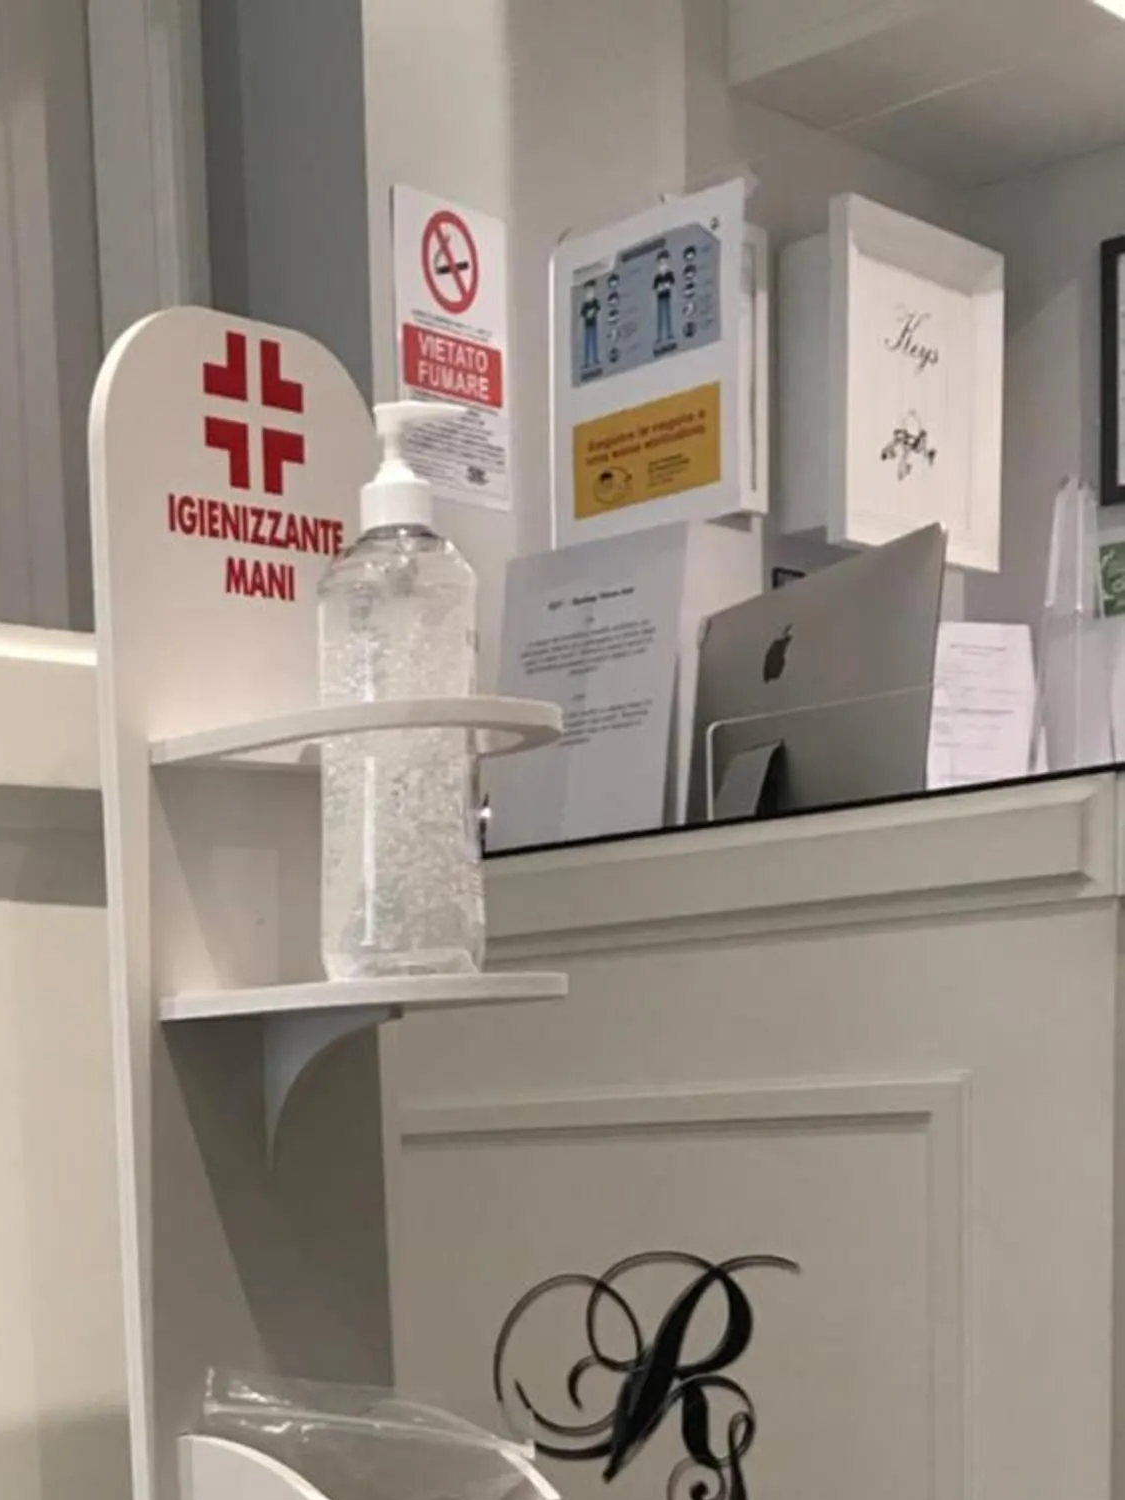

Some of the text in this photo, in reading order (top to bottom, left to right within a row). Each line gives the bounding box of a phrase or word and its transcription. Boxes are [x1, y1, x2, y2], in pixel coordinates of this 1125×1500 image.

[417, 331, 488, 374] VIETATO
[884, 305, 939, 375] Keys
[418, 359, 490, 401] FUMARE
[167, 494, 344, 556] IGIENIZZANTE
[225, 556, 296, 601] MANI
